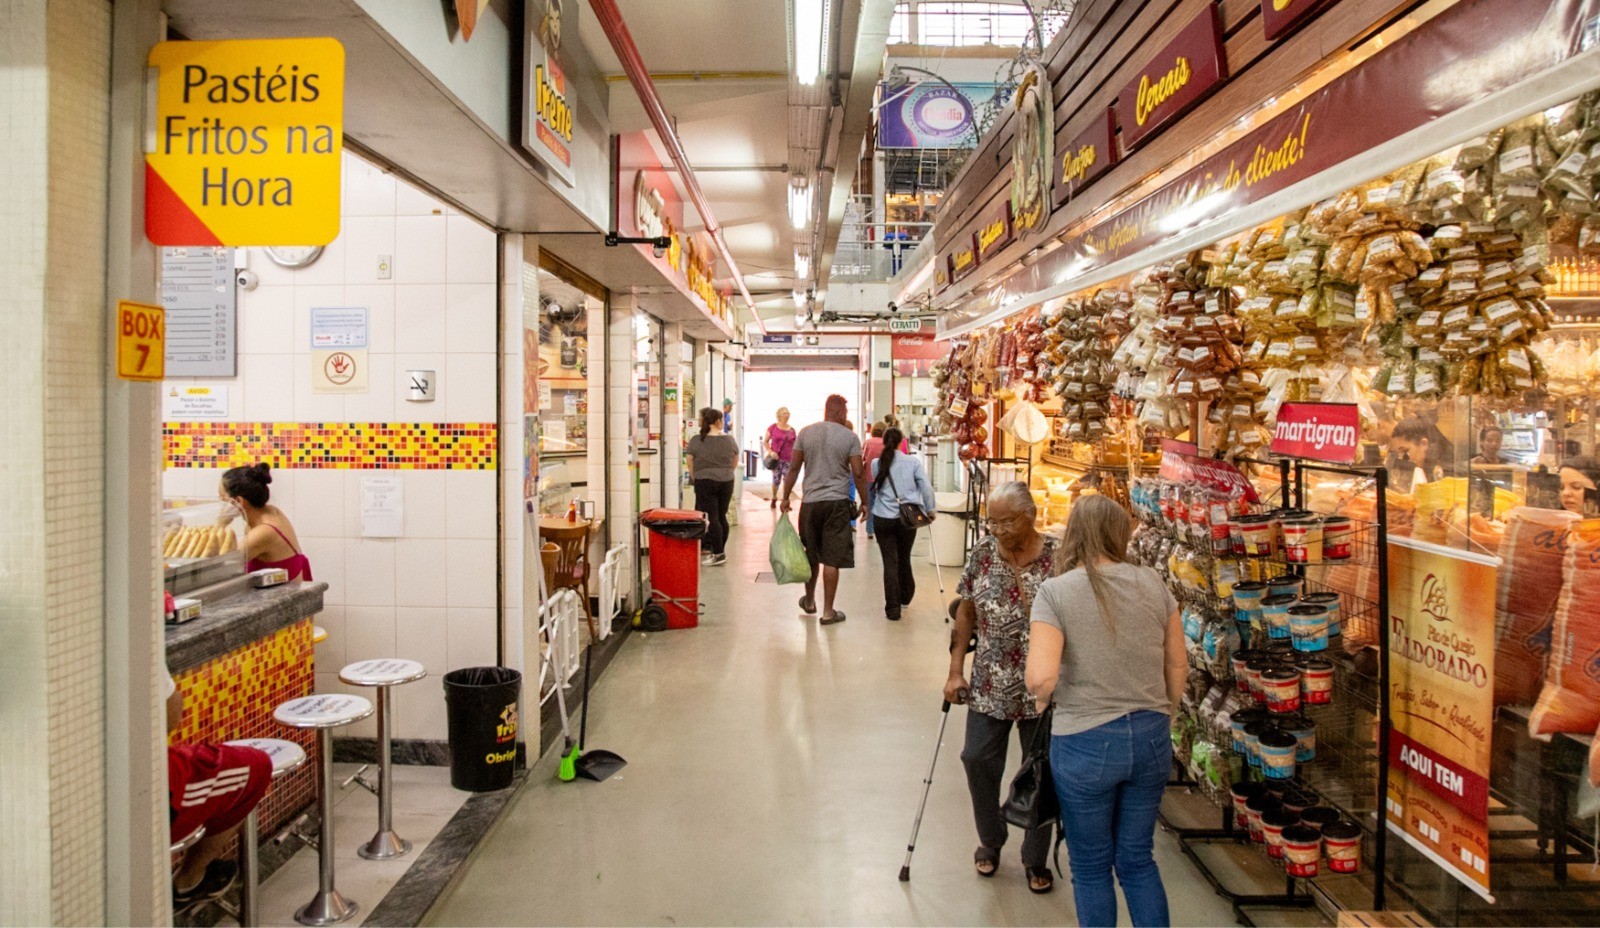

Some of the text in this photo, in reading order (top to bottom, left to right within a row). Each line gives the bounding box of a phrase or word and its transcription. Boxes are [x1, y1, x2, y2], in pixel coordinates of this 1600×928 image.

[183, 65, 320, 104] Pastéis
[536, 64, 573, 143] Irene
[1136, 56, 1191, 126] Cereais
[164, 116, 333, 155] Fritos na
[1245, 113, 1311, 187] cliente!
[202, 167, 293, 207] Hora
[122, 310, 161, 340] BOX
[891, 320, 919, 329] CERATTI
[136, 344, 150, 373] 7
[1274, 416, 1356, 450] martigran
[1390, 615, 1487, 689] ELDORADO
[1400, 744, 1433, 779] AQUI
[1434, 762, 1464, 797] TEM
